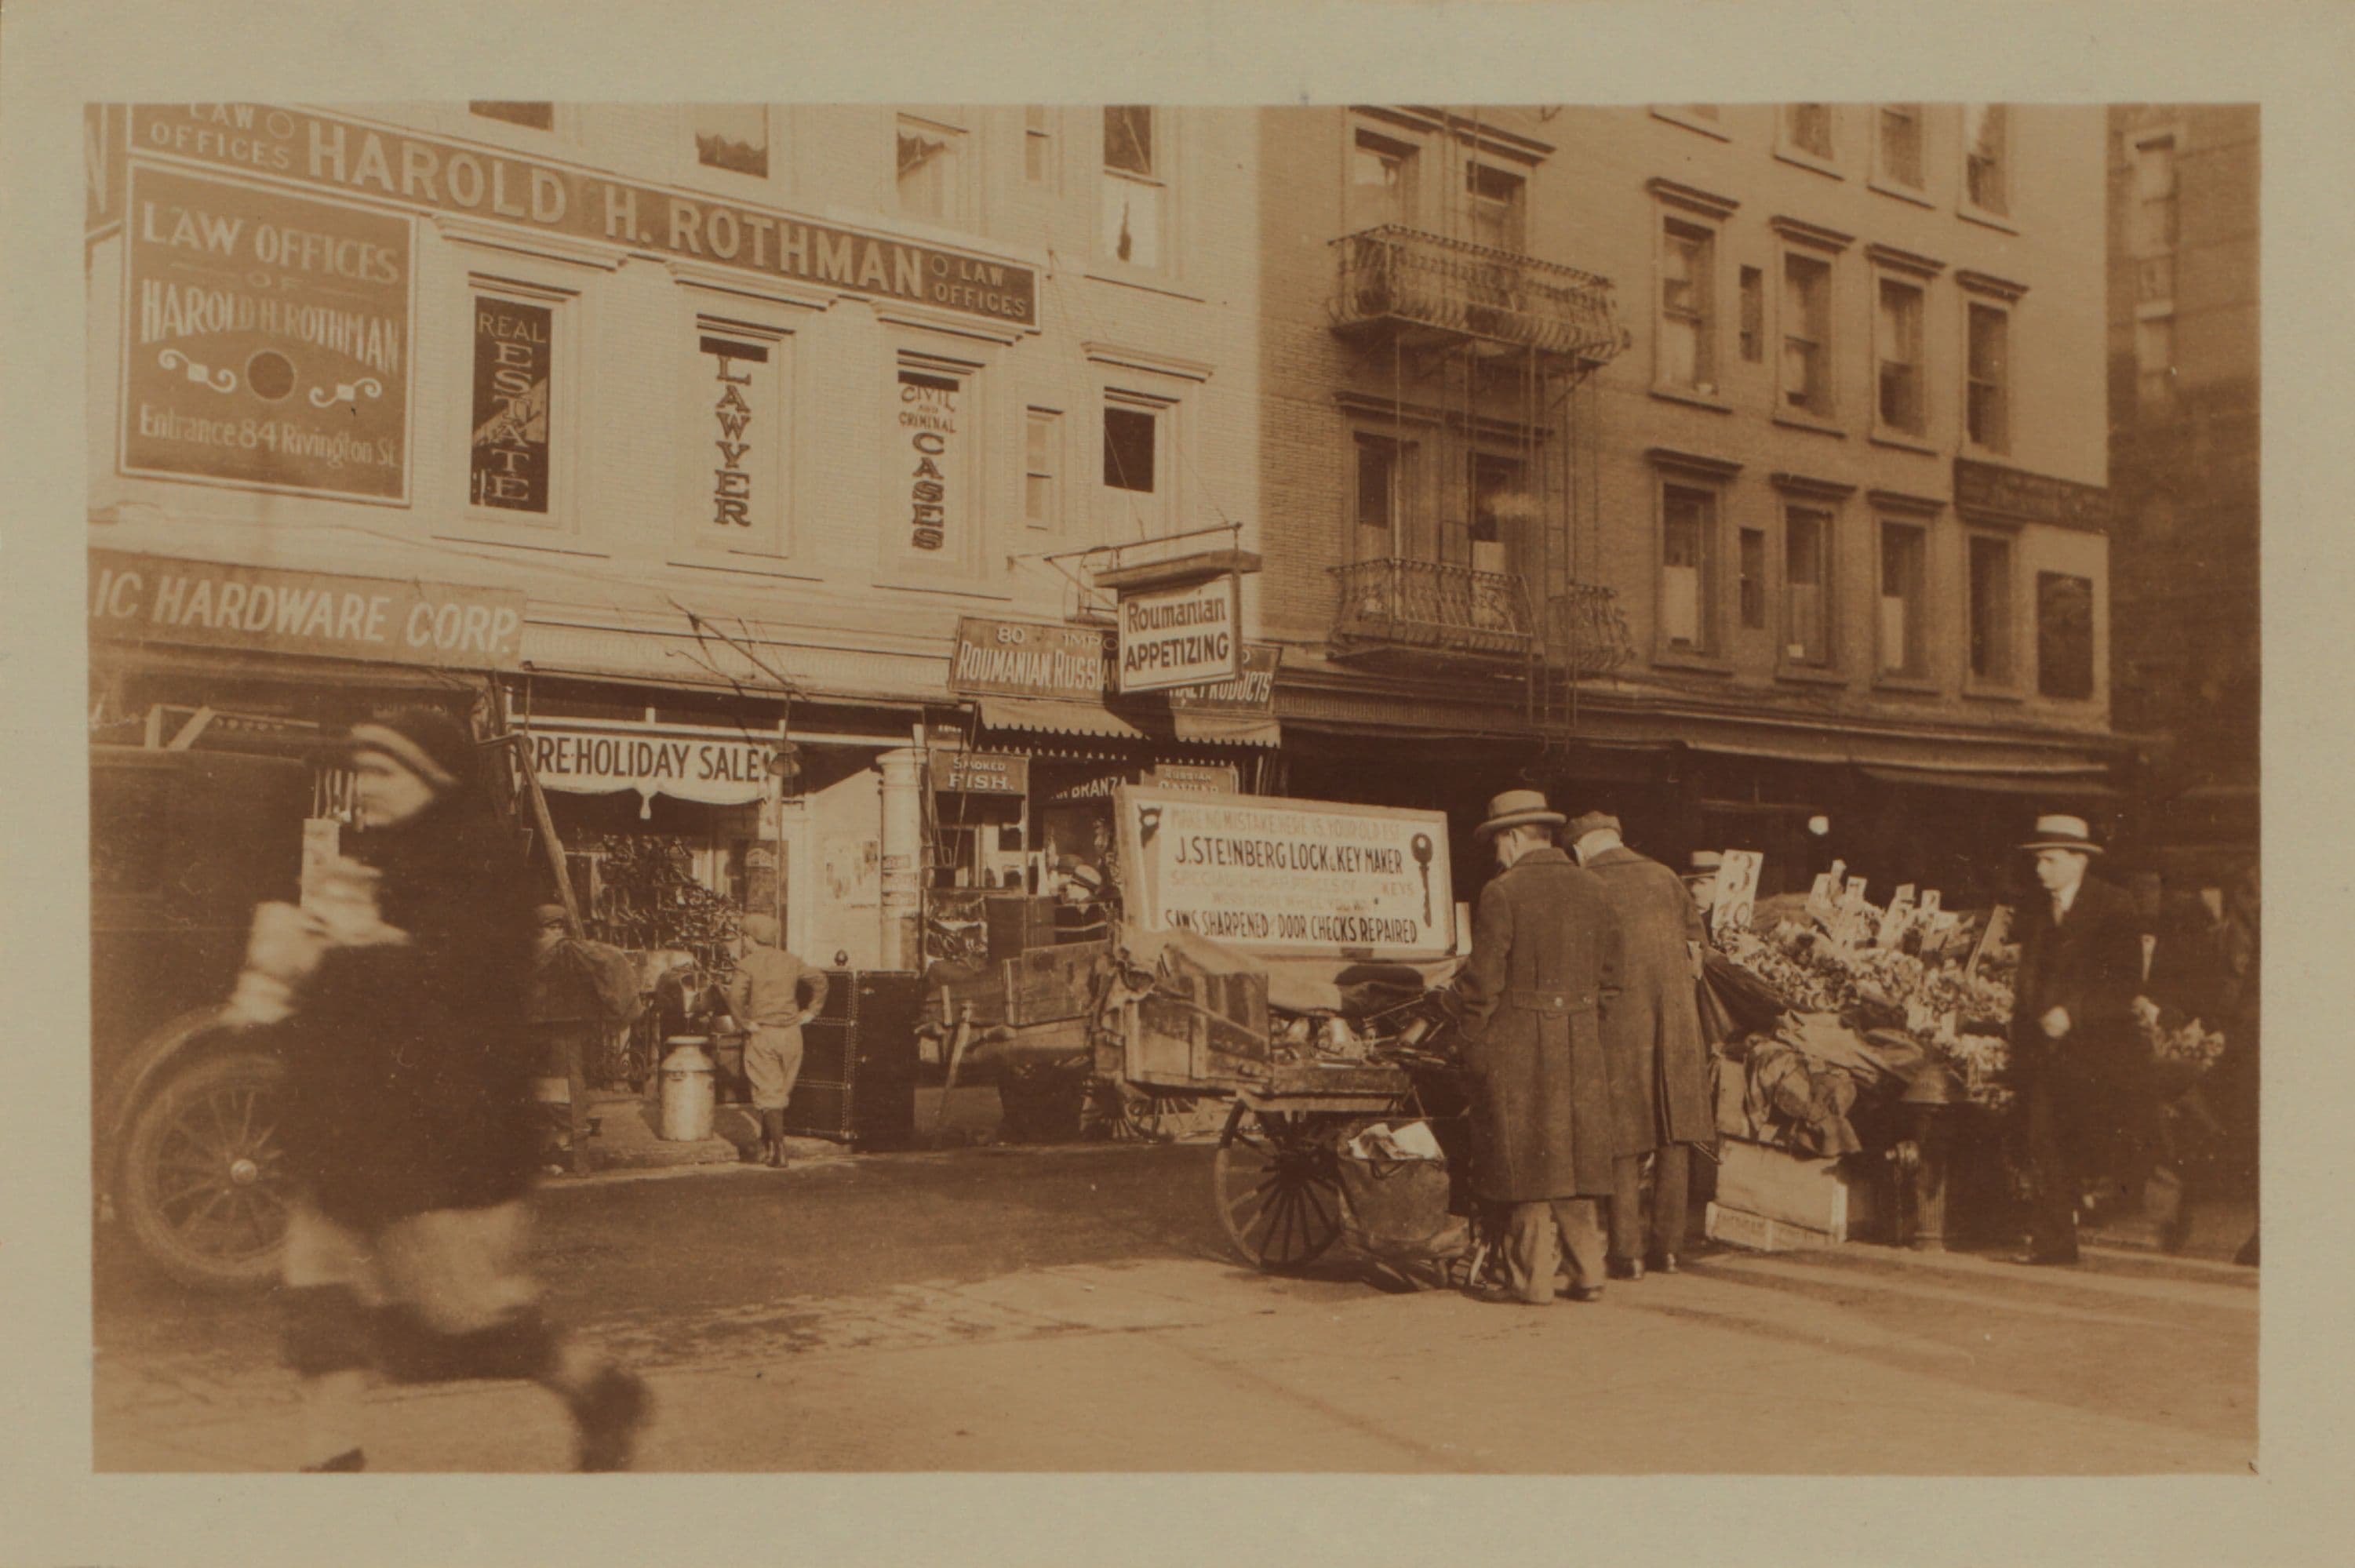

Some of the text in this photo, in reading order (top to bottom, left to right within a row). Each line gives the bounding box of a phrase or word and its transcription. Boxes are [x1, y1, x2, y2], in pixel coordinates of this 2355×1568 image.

[150, 122, 289, 170] OFFICES
[308, 120, 924, 299] HAROLD H. ROTHMAN
[142, 201, 400, 286] LAW OFFICES
[246, 269, 304, 293] OF
[959, 260, 1003, 287] LAW
[934, 283, 1026, 318] OFFICES
[140, 278, 256, 345] HAROLD
[283, 302, 400, 376] ROTHMAN
[476, 311, 547, 344] REAL
[139, 402, 235, 447] Entrance
[238, 418, 278, 453] 84
[281, 421, 373, 469] Rivington
[493, 341, 533, 502] ESTATE
[713, 356, 752, 527] LAWYER
[898, 410, 957, 434] CRIMINAL
[912, 431, 945, 551] CASES
[151, 573, 392, 643] HARDWARE
[405, 602, 522, 655] CORP.
[1127, 596, 1226, 635] Roumanian
[996, 627, 1027, 646] 80
[1123, 631, 1230, 673] APPETIZING
[1289, 842, 1327, 871] LOCK
[1337, 846, 1361, 873] KEY
[1364, 848, 1403, 875] MAKER
[1202, 909, 1269, 939] SHARPENED
[1277, 914, 1307, 940] DOOR
[1311, 916, 1357, 942] CHECKS
[1359, 917, 1418, 944] REPAIRED
